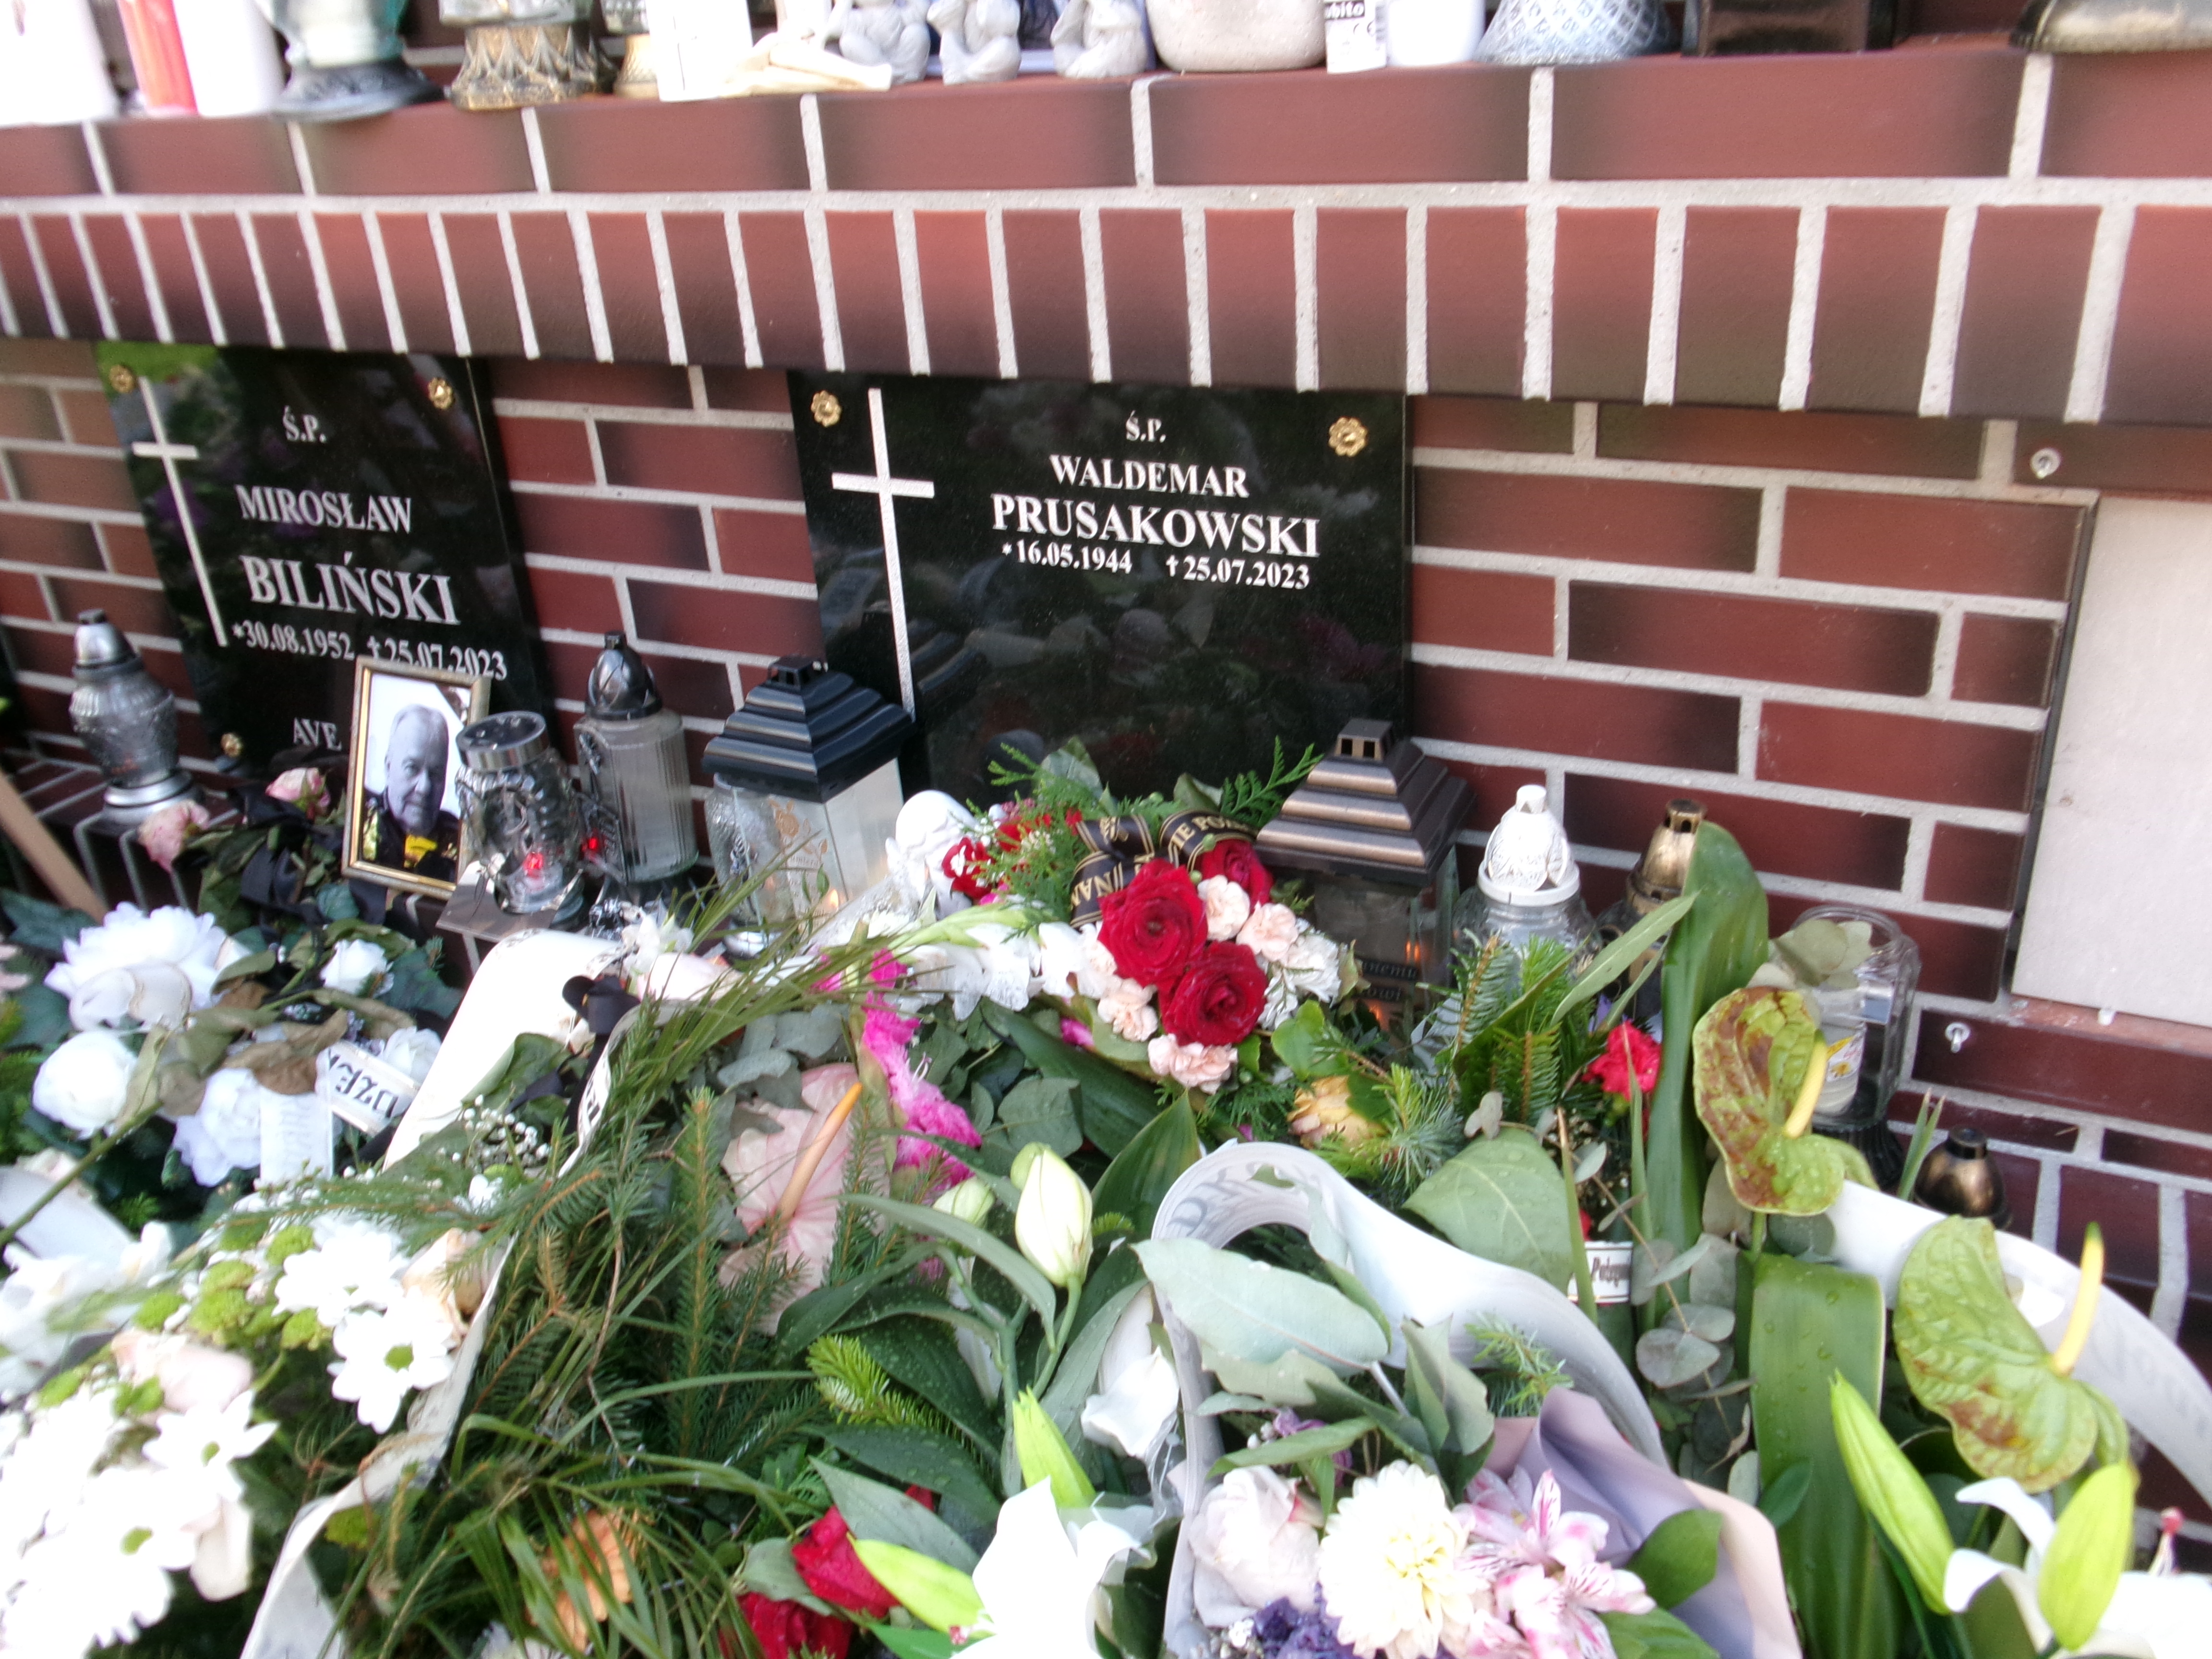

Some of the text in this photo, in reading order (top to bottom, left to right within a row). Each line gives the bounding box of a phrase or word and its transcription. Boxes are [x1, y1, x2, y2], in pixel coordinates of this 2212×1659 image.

[282, 406, 327, 443] Ś.P.
[1125, 410, 1166, 443] Ś.P.
[1050, 454, 1250, 498] WALDEMAR
[235, 485, 411, 534] MIROSŁAW
[990, 493, 1320, 557] PRUSAKOWSKI
[240, 551, 460, 625] BILIŃSKI
[293, 717, 342, 751] AVE
